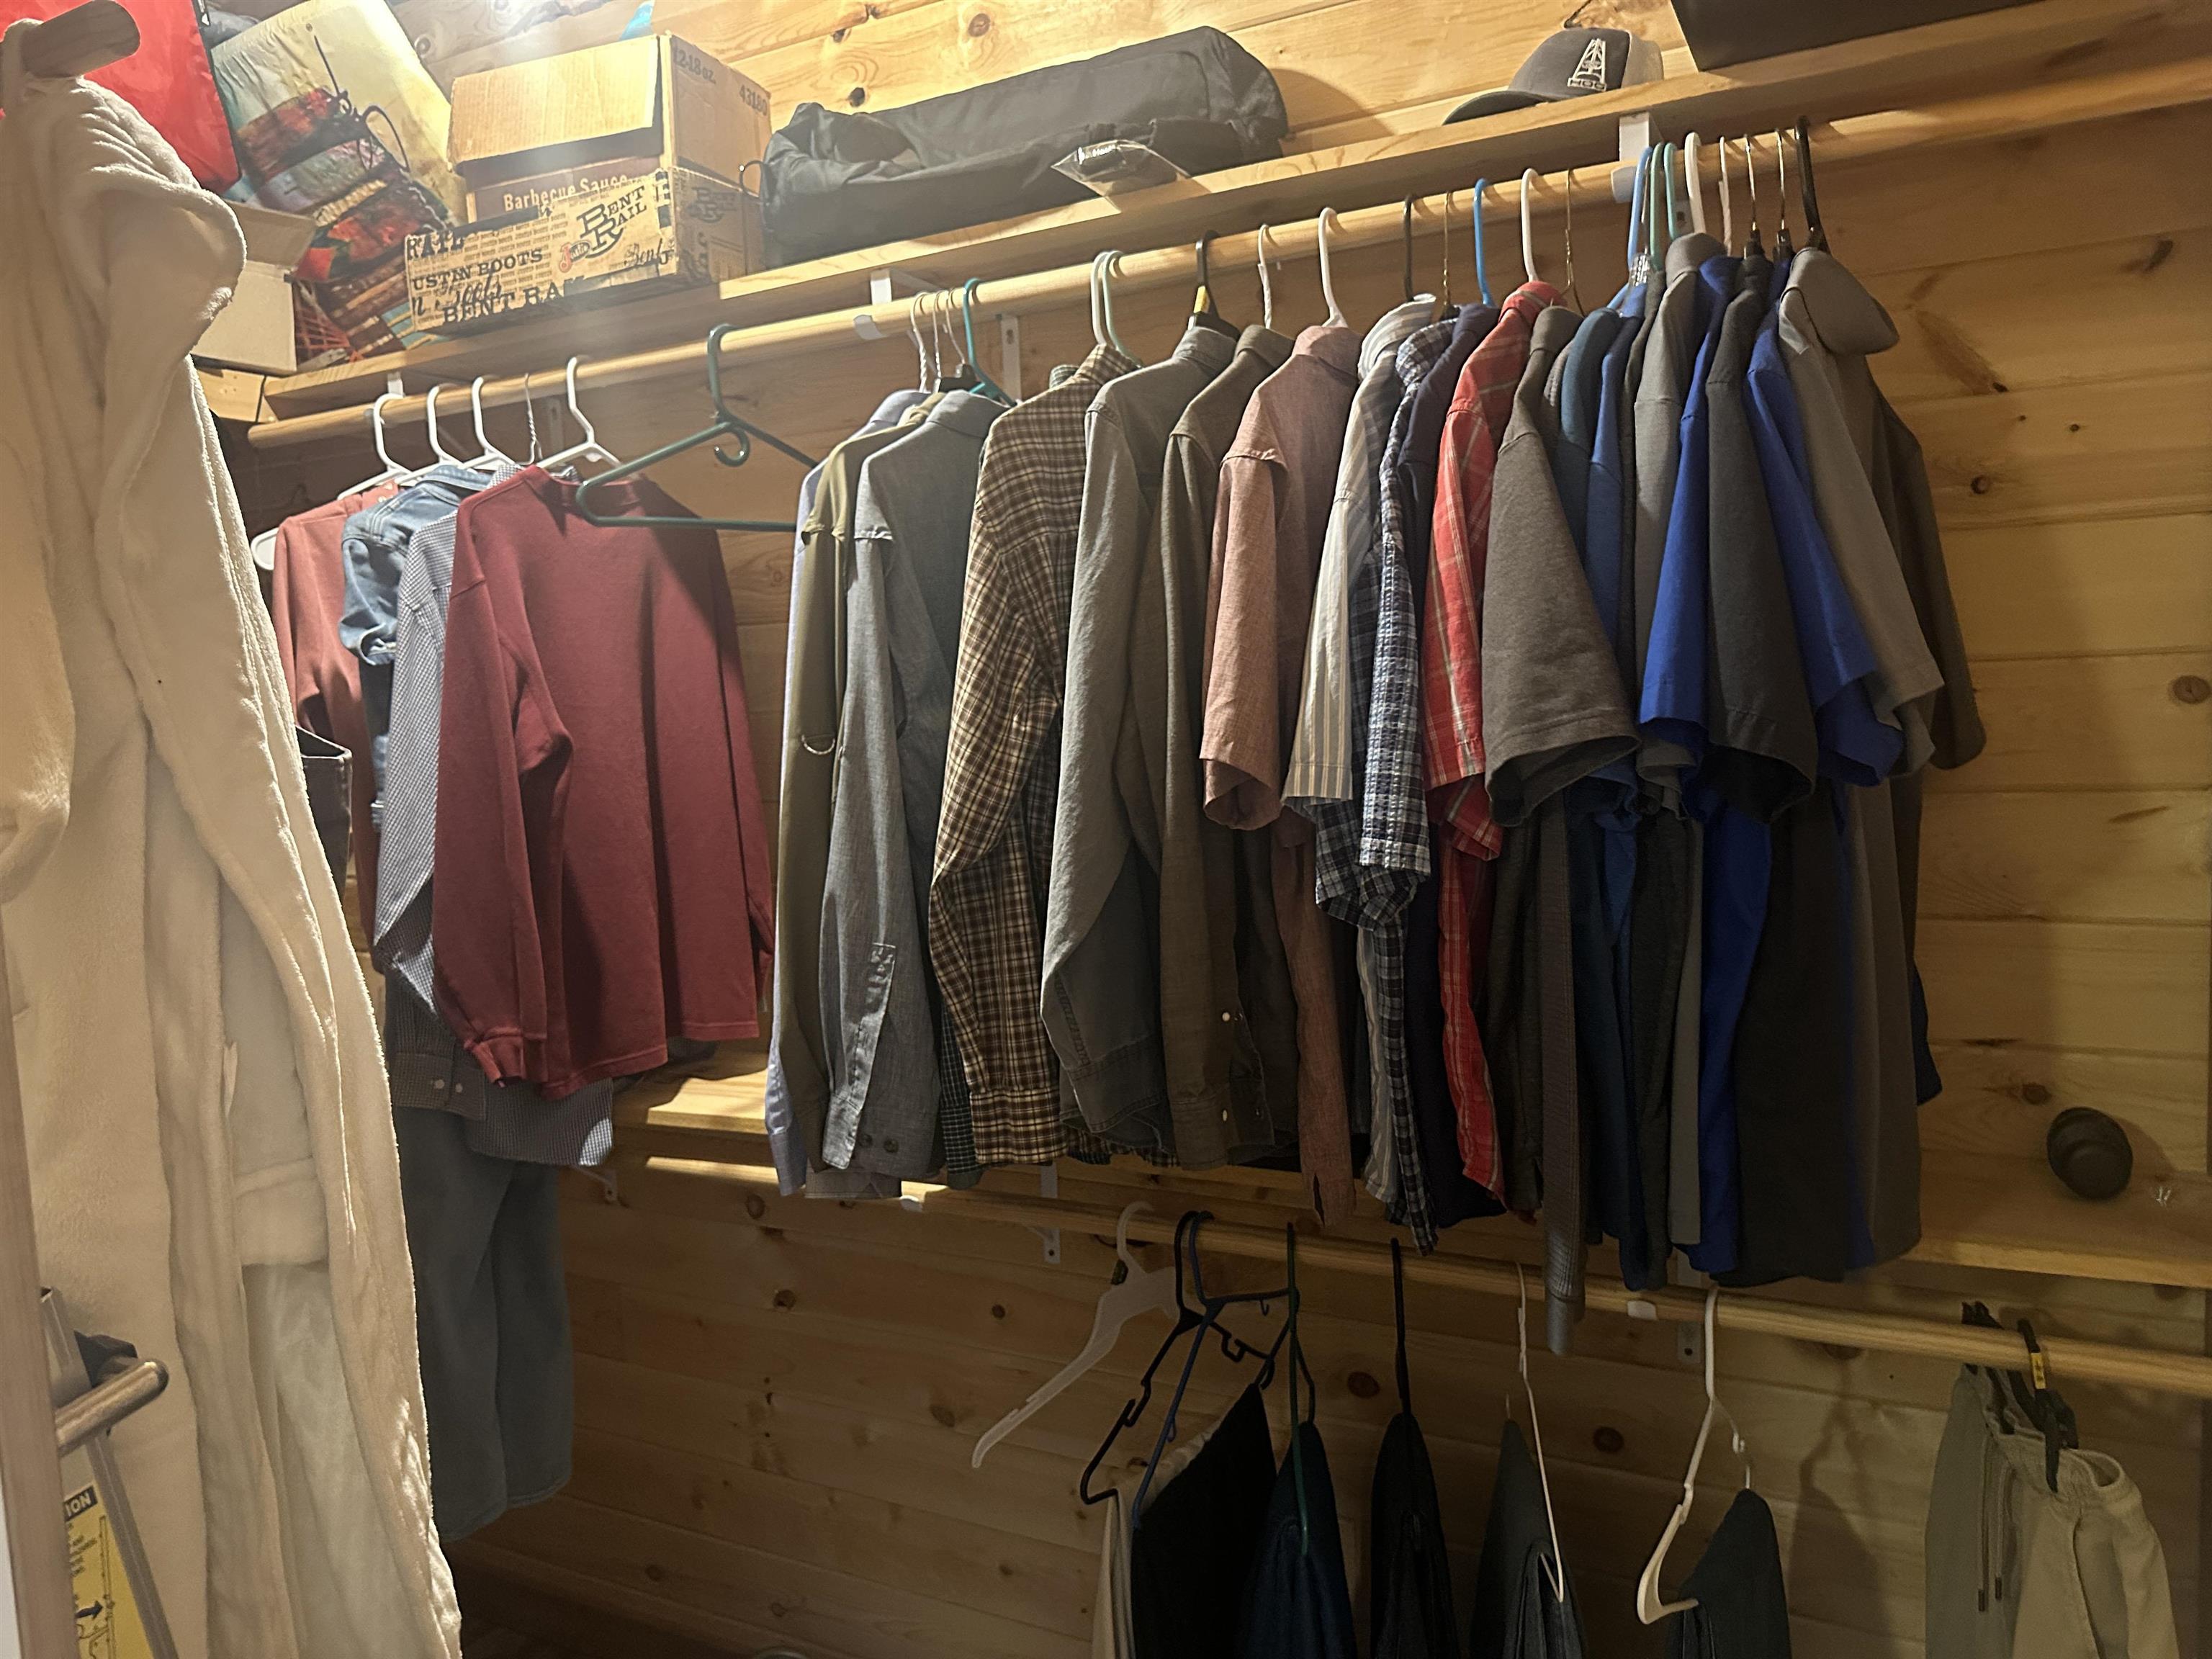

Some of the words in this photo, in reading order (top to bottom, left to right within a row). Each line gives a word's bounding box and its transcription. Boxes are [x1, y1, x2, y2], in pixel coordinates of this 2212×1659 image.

[503, 184, 576, 212] Barbecue
[576, 185, 645, 240] BENT
[585, 202, 647, 259] RAIL
[477, 247, 543, 276] BOOTS
